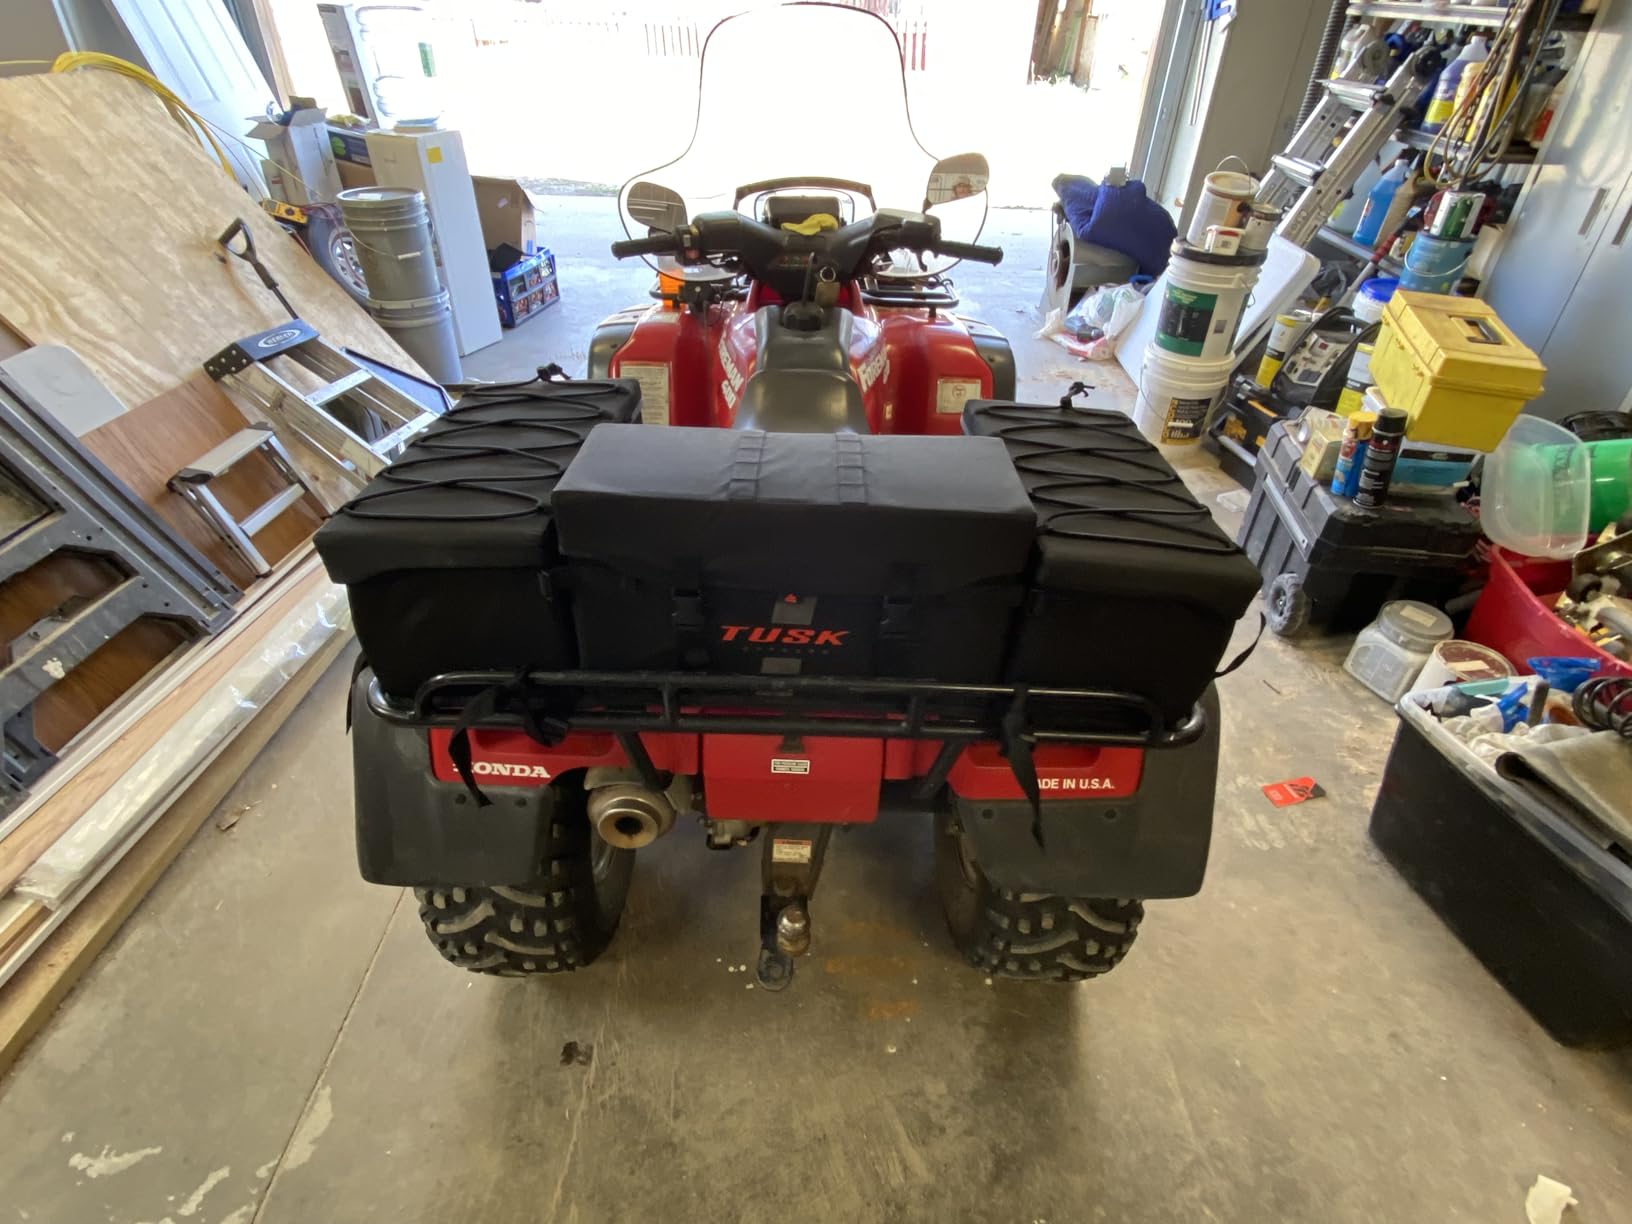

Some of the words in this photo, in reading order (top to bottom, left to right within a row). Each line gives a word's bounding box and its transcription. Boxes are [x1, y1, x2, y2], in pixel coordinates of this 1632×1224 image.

[720, 625, 850, 646] TUSK
[1062, 778, 1076, 789] IN
[1079, 778, 1115, 790] U.S.A.
